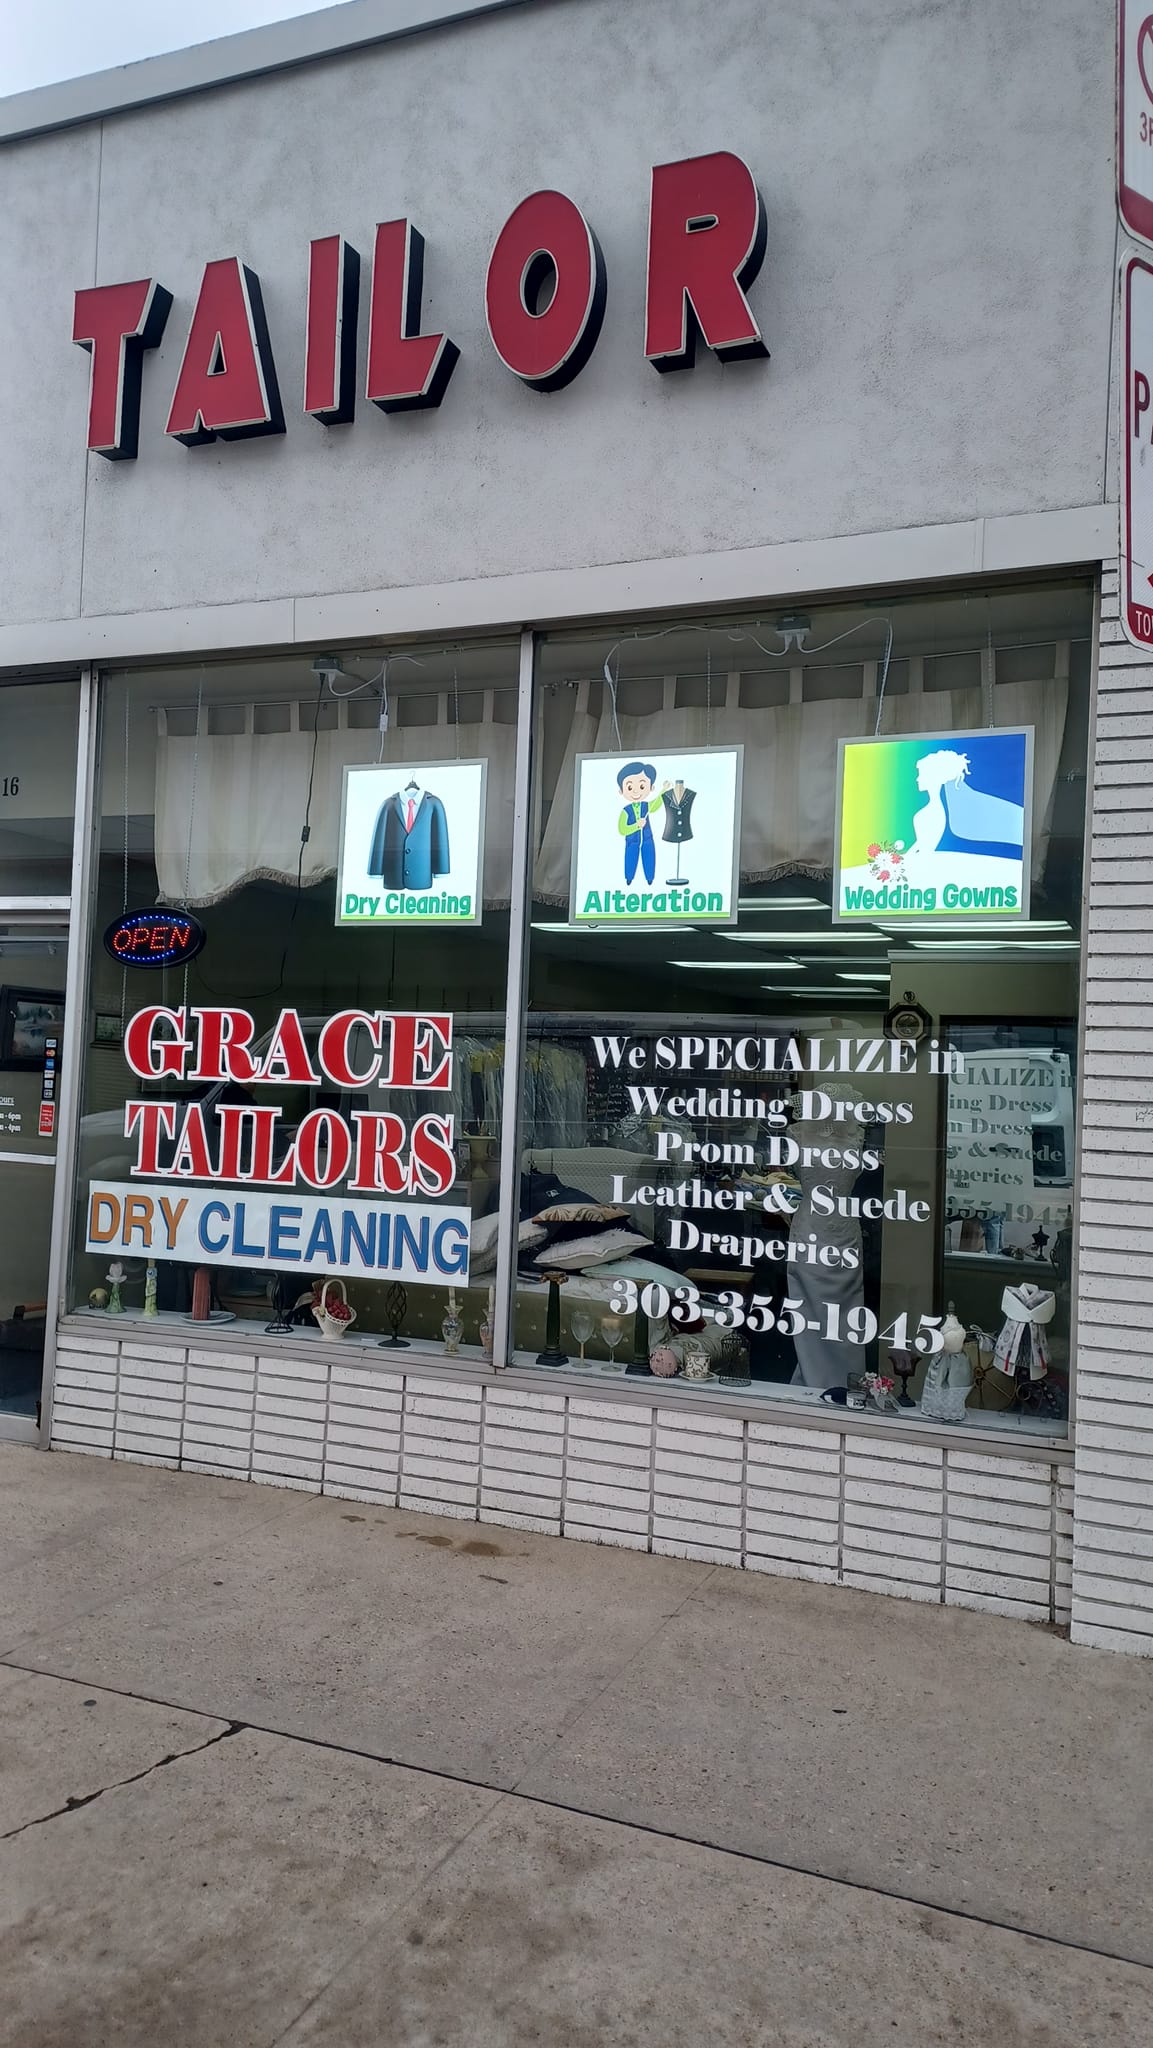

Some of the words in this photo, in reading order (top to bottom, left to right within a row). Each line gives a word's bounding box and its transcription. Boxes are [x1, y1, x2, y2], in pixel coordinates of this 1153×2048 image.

[72, 151, 770, 459] TAILOR
[345, 893, 380, 916] Dry
[386, 891, 471, 916] Cleaning
[583, 888, 723, 913] Alteration
[845, 884, 937, 911] Wedding
[943, 883, 1018, 909] Gowns
[113, 925, 192, 951] OPEN
[125, 1006, 453, 1091] GRACE
[591, 1036, 647, 1069] We
[655, 1036, 918, 1074] SPECIALIZE
[928, 1039, 966, 1075] in
[626, 1085, 789, 1128] Wedding
[799, 1090, 914, 1124] Dress
[124, 1100, 457, 1197] TAILORS
[654, 1131, 755, 1166] Prom
[766, 1135, 880, 1171] Dress
[609, 1175, 754, 1211] Leather
[762, 1183, 800, 1214] &
[810, 1184, 930, 1222] Suede
[88, 1191, 189, 1250] DRY
[198, 1201, 470, 1275] CLEANING
[666, 1218, 859, 1269] Draperies
[609, 1279, 945, 1354] 303-355-1945
